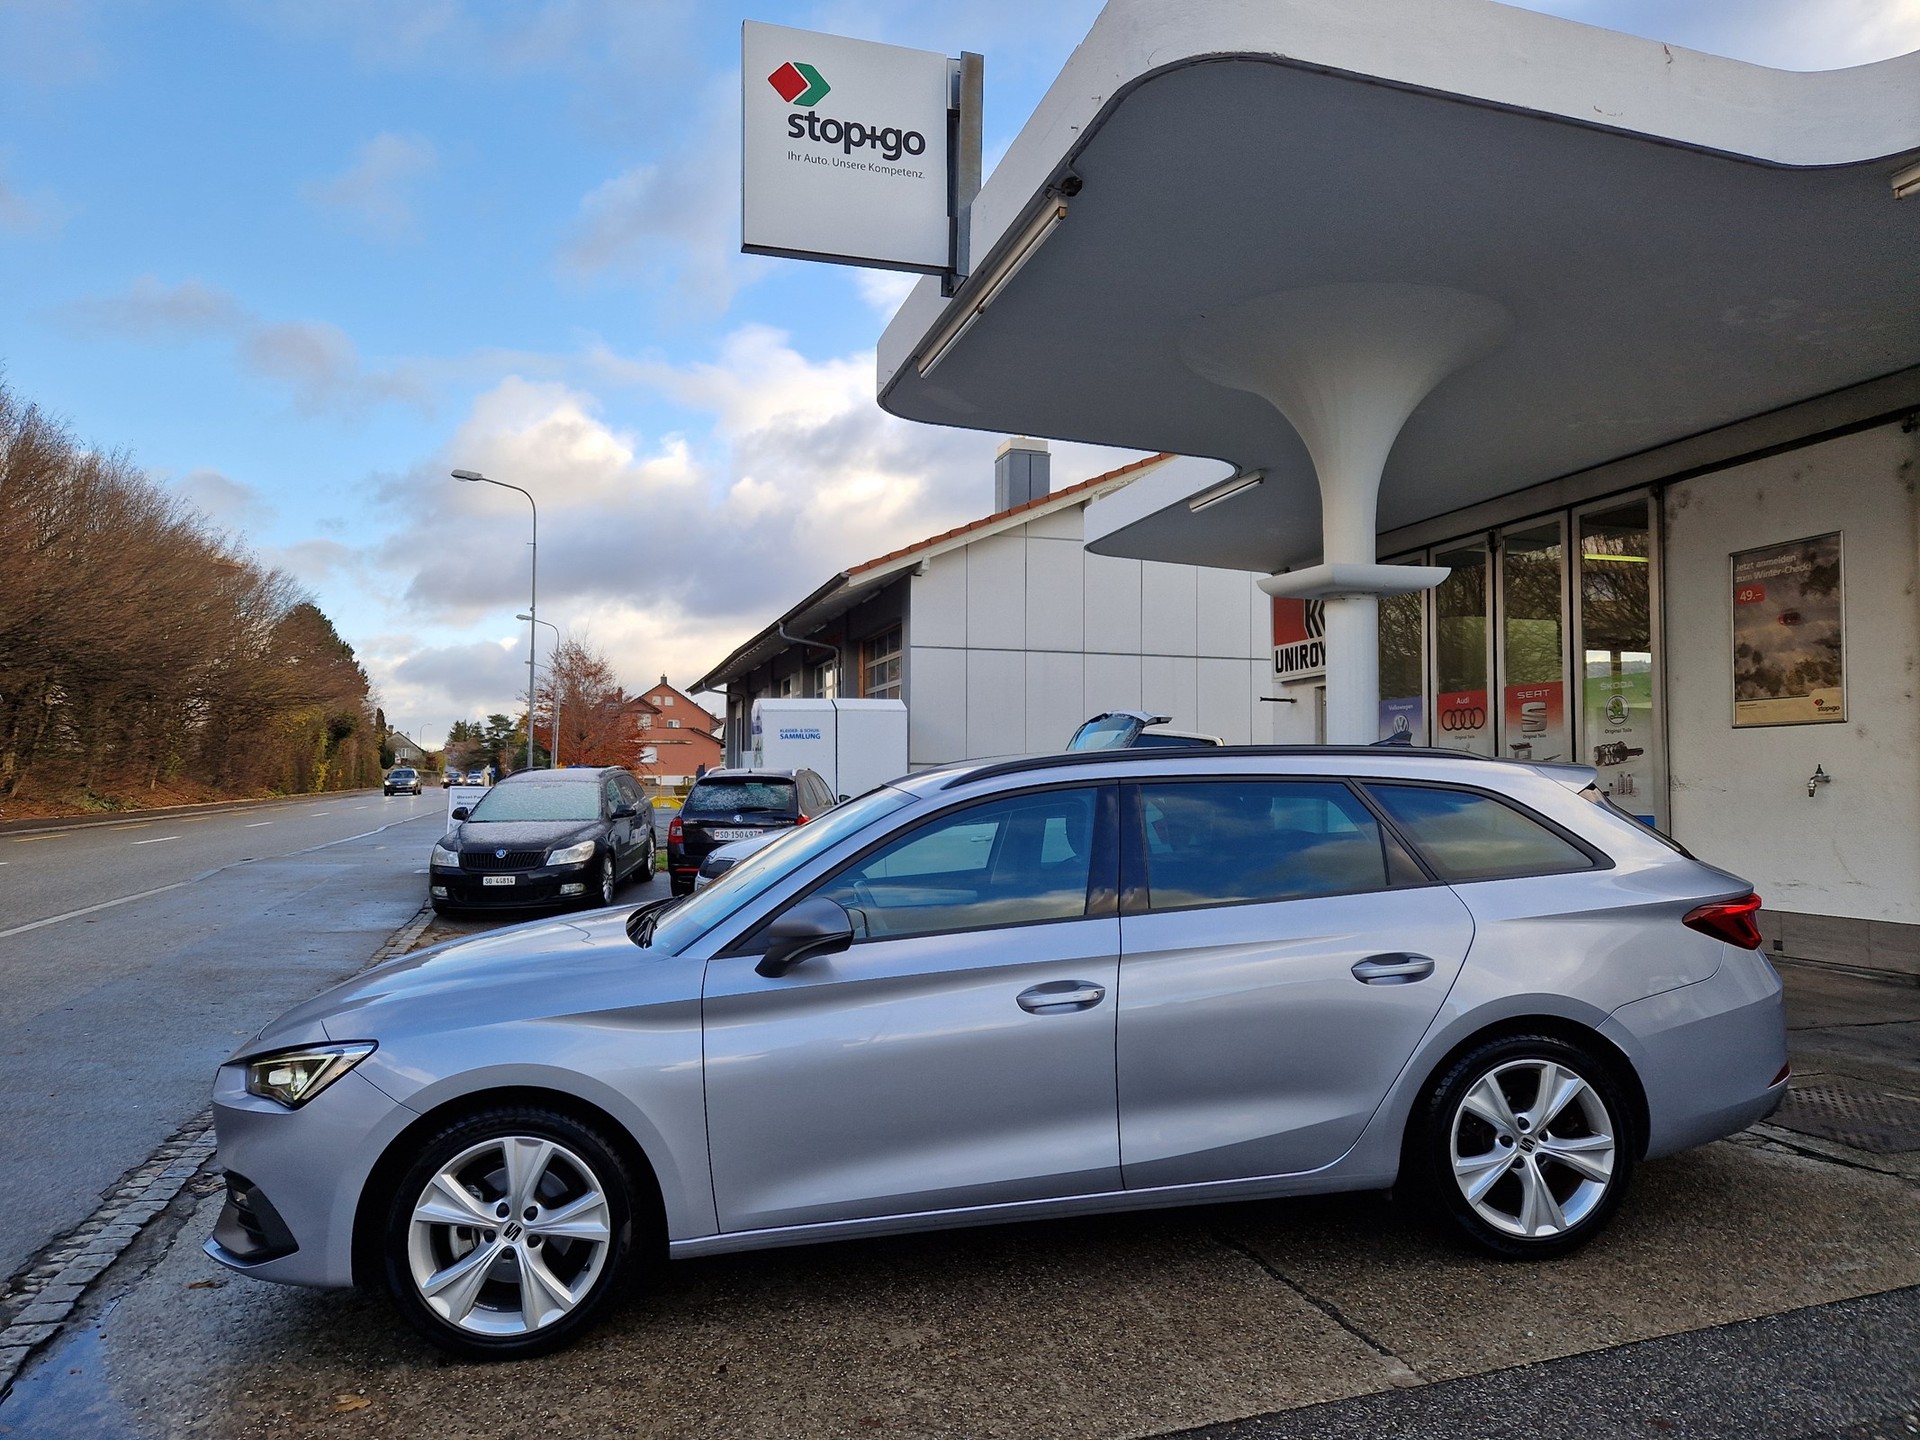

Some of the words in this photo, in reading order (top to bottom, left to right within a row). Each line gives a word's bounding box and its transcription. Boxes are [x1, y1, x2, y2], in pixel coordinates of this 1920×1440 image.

[787, 110, 926, 161] stop+go
[787, 151, 802, 162] Ihr
[803, 152, 831, 166] Auto.
[832, 158, 867, 172] Unsere
[868, 162, 926, 180] Kompetenz.
[1736, 561, 1754, 572] Jetzt
[1756, 555, 1797, 568] anmelden
[1736, 574, 1753, 583] zum
[1456, 696, 1470, 705] Audi
[1517, 688, 1550, 700] SEAT
